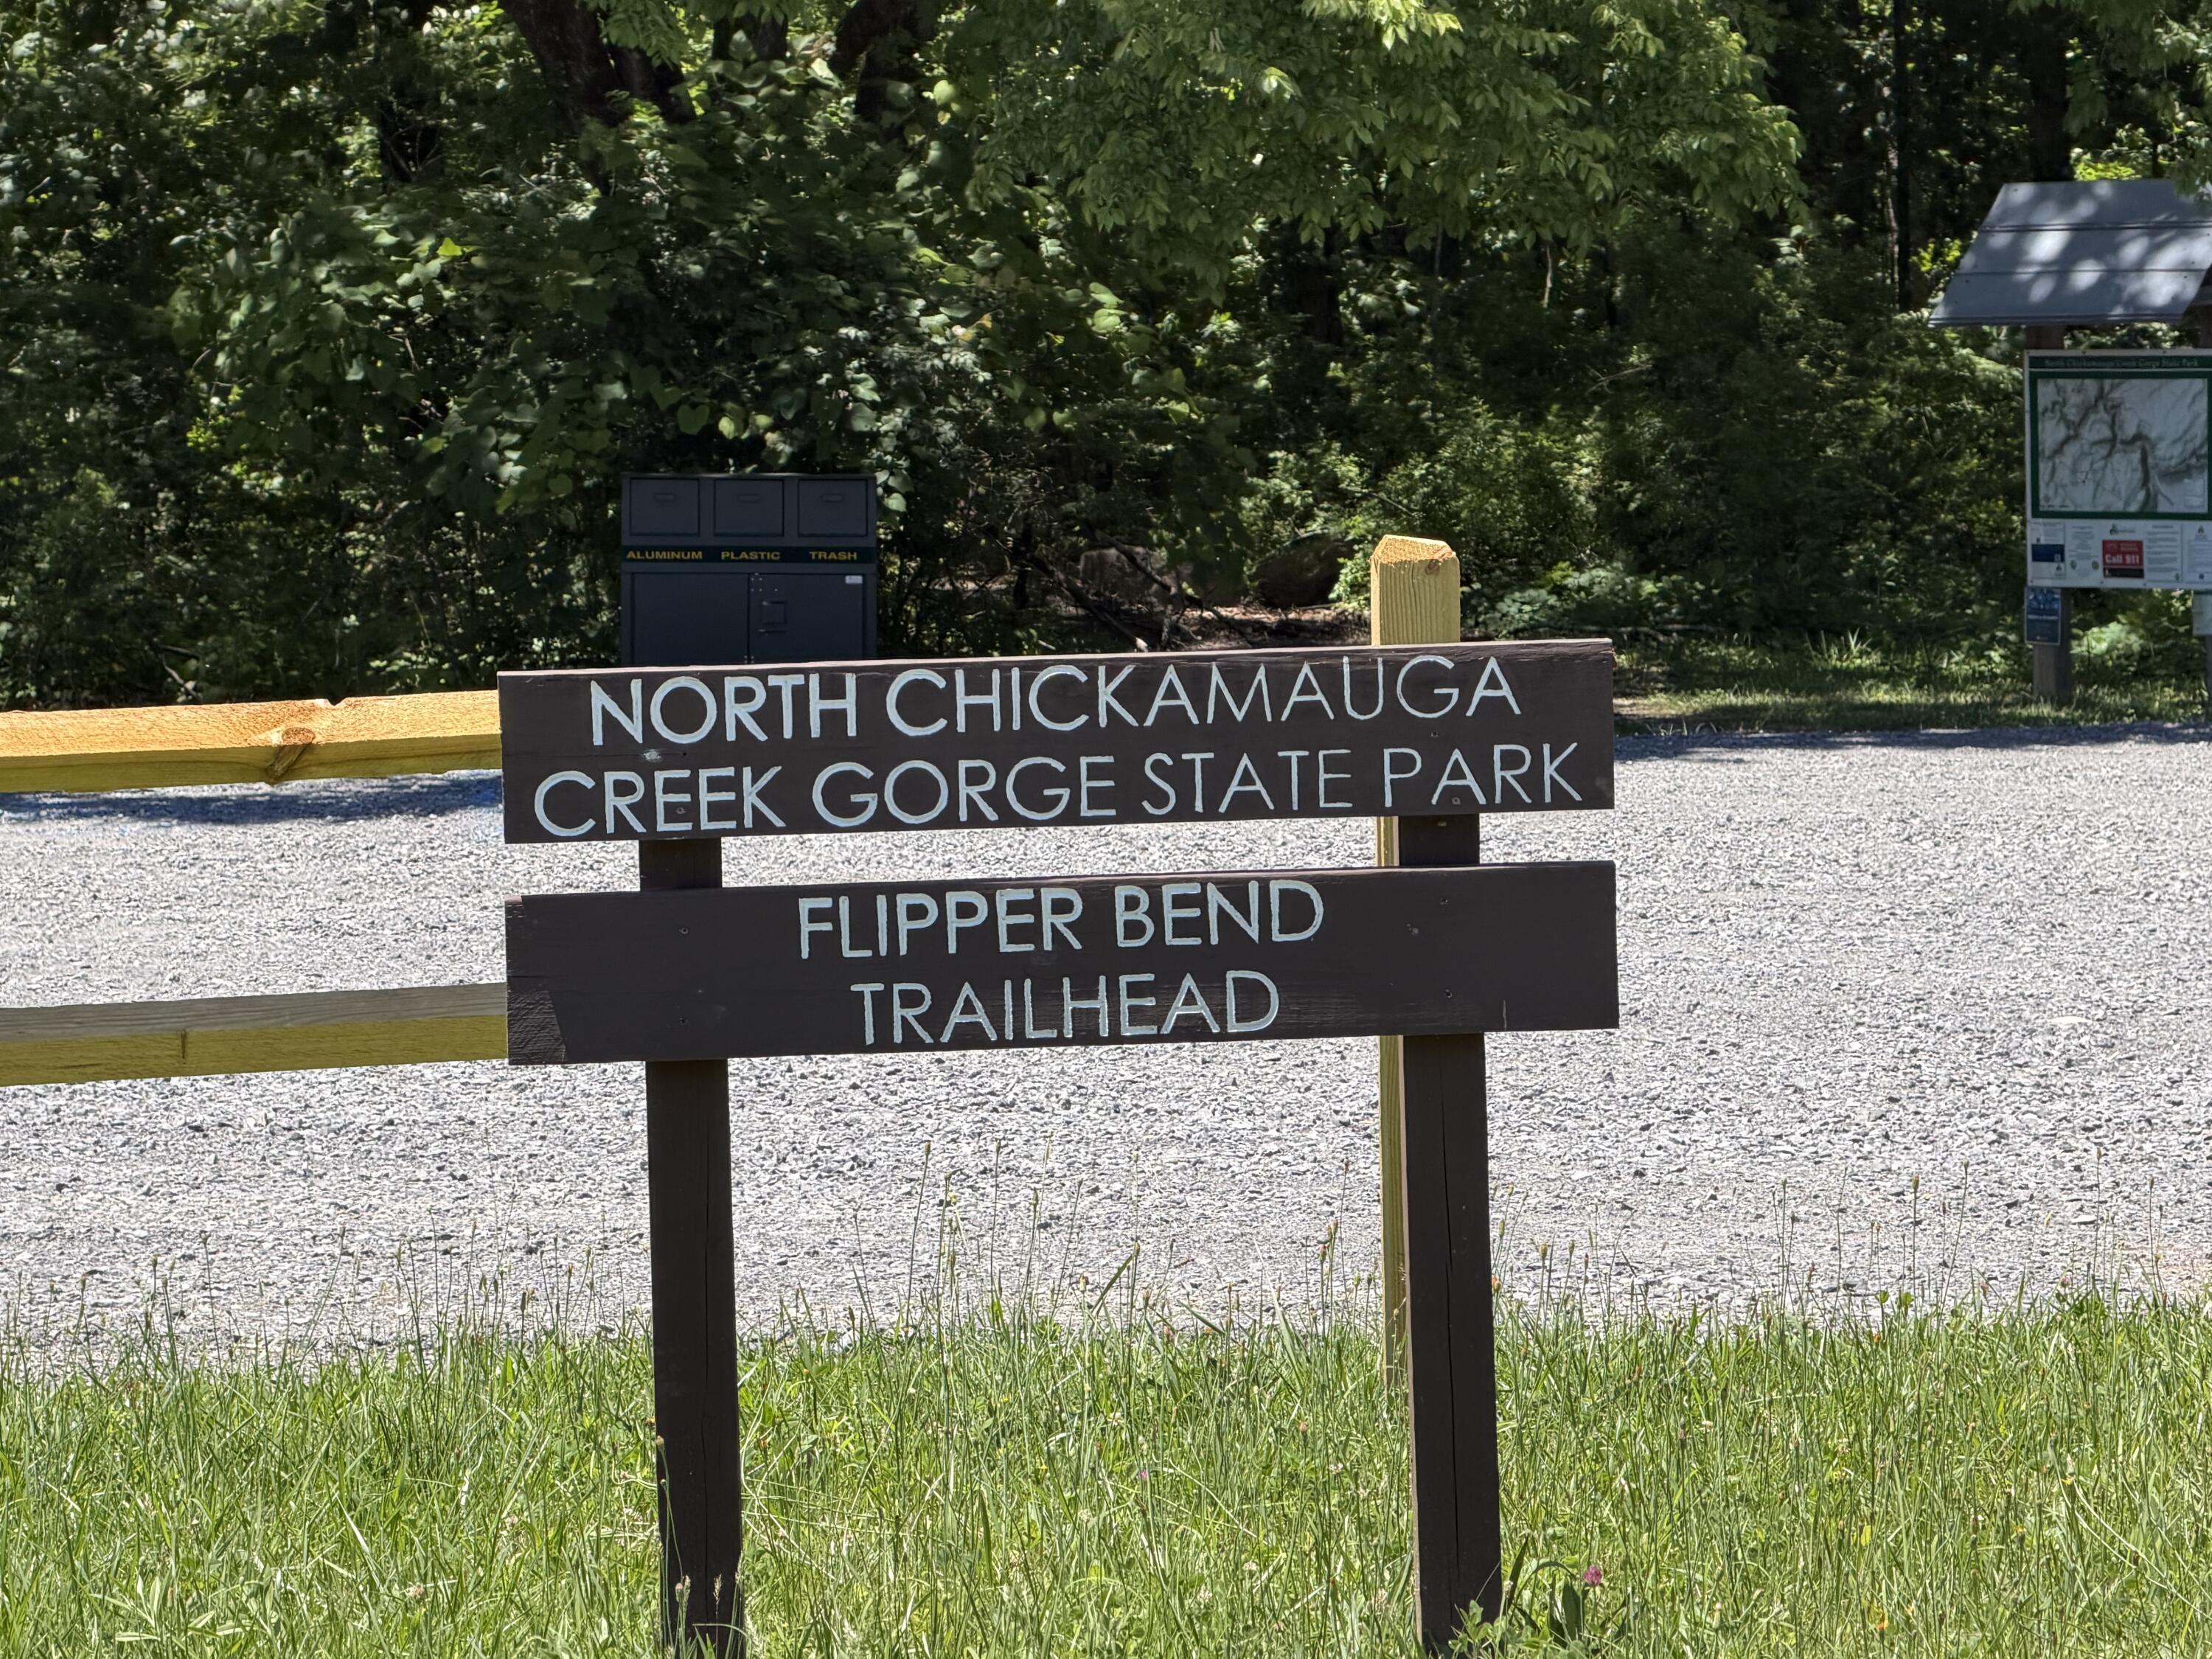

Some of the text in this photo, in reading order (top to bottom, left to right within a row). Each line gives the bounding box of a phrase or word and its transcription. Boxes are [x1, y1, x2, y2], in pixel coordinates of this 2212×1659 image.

[627, 551, 858, 560] ALUMINUM PLASTIC TRASH
[2105, 554, 2140, 564] Call 911
[590, 654, 1522, 745] NORTH CHICKAMAUGA
[534, 742, 1583, 837] CREEK GORGE STATE PARK
[798, 879, 1324, 959] FLIPPER BEND
[850, 970, 1279, 1046] TRAILHEAD
